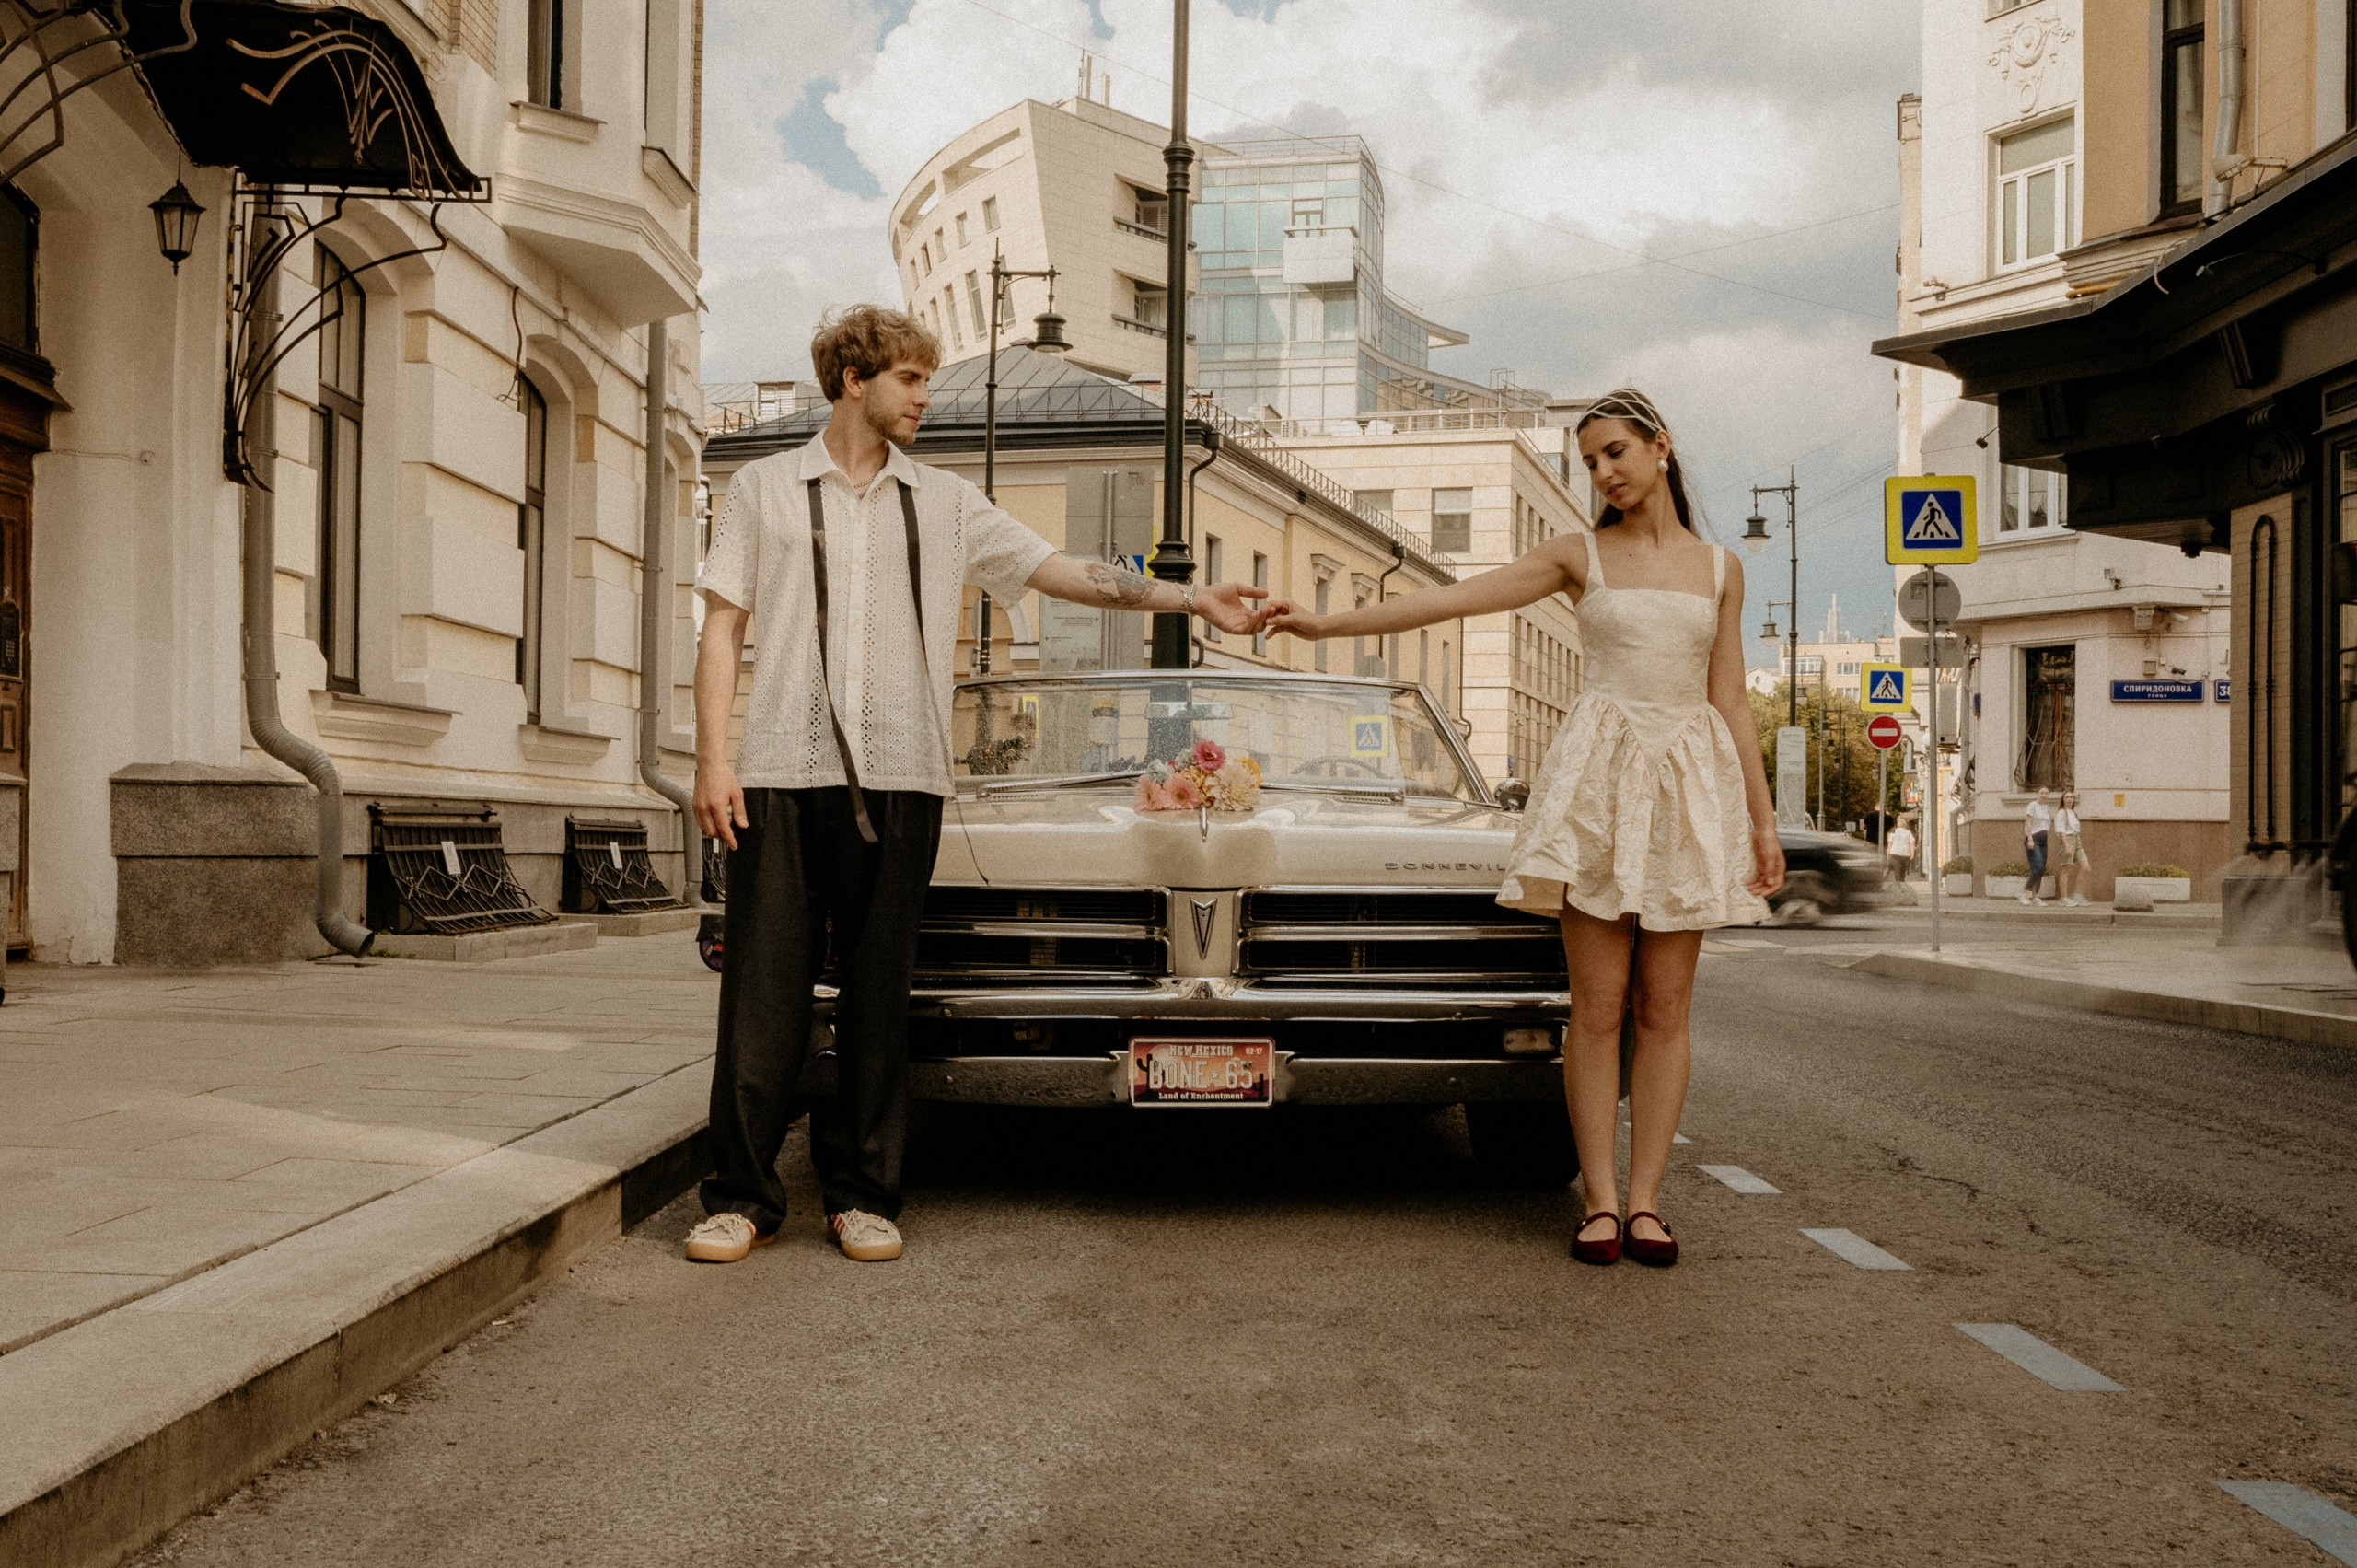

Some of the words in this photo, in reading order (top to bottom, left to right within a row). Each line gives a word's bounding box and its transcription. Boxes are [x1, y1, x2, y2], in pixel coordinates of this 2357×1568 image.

[2123, 684, 2192, 692] СПИРИДОНОВКА
[1169, 1045, 1193, 1056] NEW
[1195, 1045, 1234, 1056] MEXICO
[1149, 1060, 1208, 1089] BONE
[1225, 1060, 1253, 1089] 65
